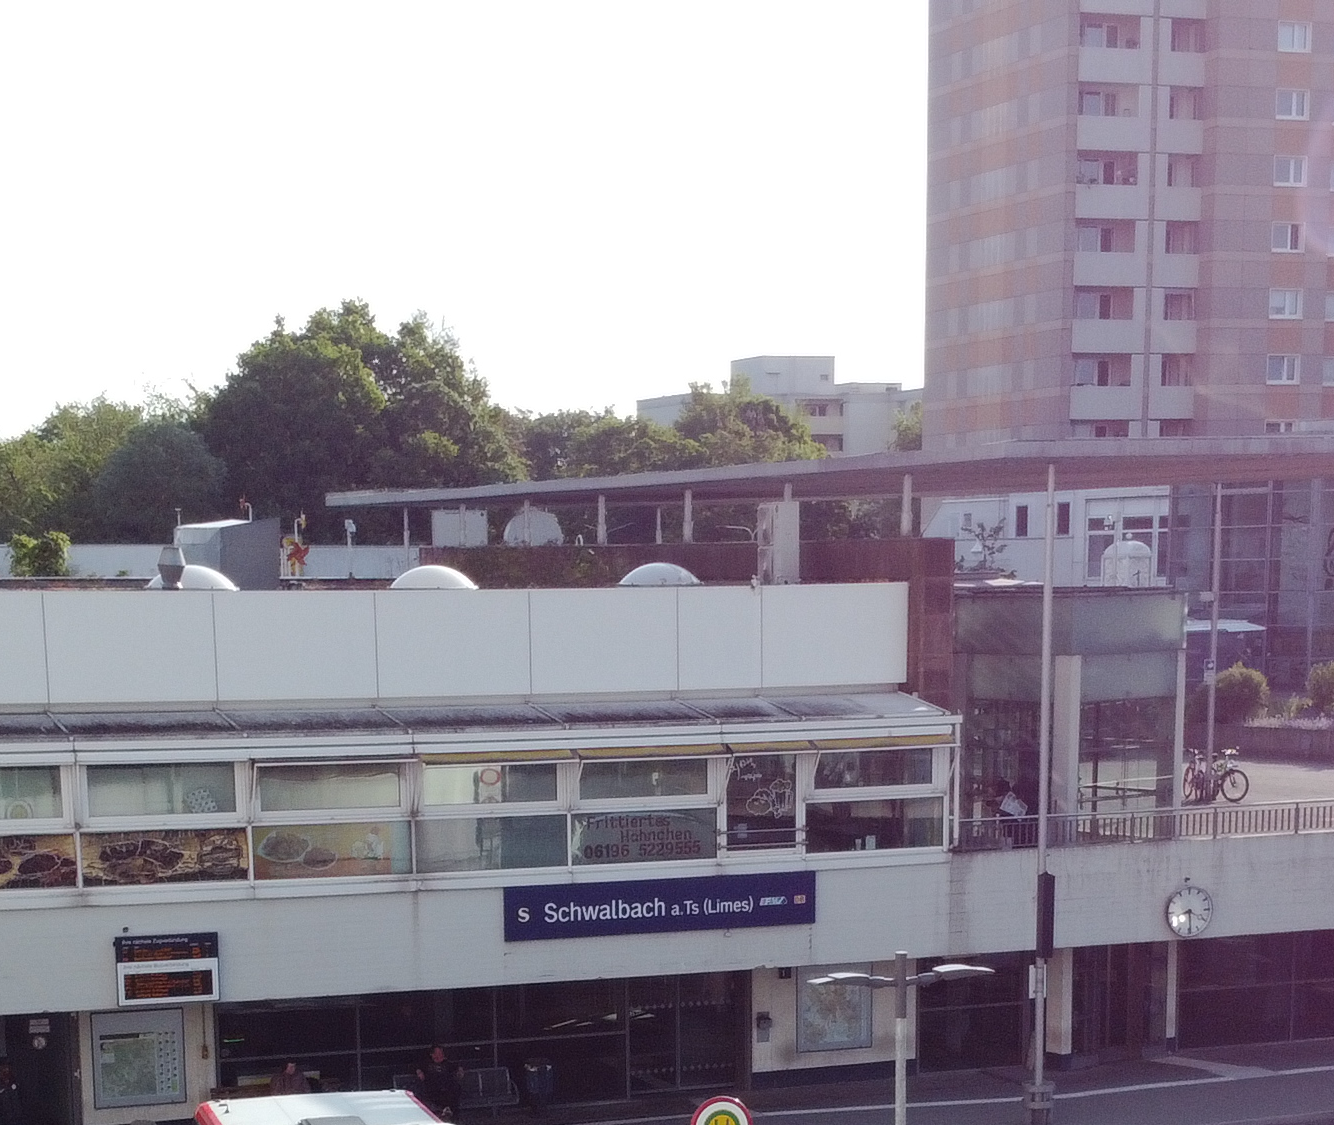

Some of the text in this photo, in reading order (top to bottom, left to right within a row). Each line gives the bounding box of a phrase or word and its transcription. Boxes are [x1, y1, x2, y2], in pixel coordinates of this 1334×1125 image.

[586, 814, 671, 829] Frittiertes
[583, 840, 701, 859] 06196 5229555
[517, 907, 530, 923] S
[544, 897, 666, 923] Schwalbach
[671, 900, 699, 916] a.Ts
[703, 896, 754, 916] (Limes)
